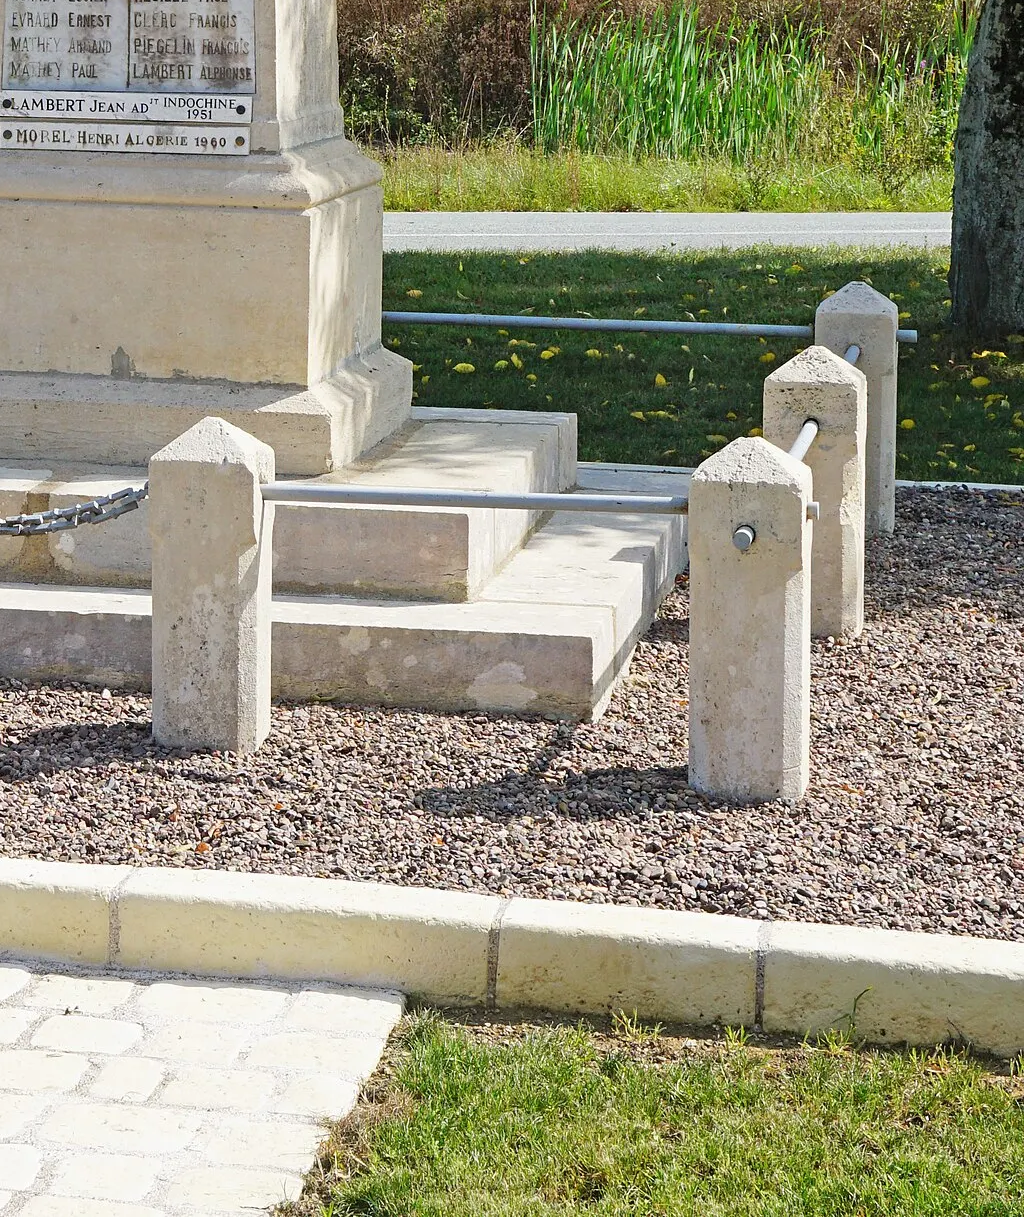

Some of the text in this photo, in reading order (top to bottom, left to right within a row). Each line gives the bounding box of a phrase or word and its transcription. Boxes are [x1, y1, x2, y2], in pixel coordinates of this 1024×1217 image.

[11, 12, 112, 28] EVRARD ERNEST
[133, 11, 237, 29] CLERC FRANCIS
[10, 36, 62, 53] MATHEY
[10, 61, 98, 79] MATHEY PAUL
[132, 63, 253, 81] LAMBERT ALPHONSE
[10, 98, 85, 112] LAMBERT
[89, 100, 125, 112] JEAN
[163, 97, 237, 110] INDOCHINE
[186, 109, 213, 120] 1951
[77, 130, 120, 145] HENRI
[125, 132, 188, 147] ALGERIE
[194, 136, 227, 148] 1960
